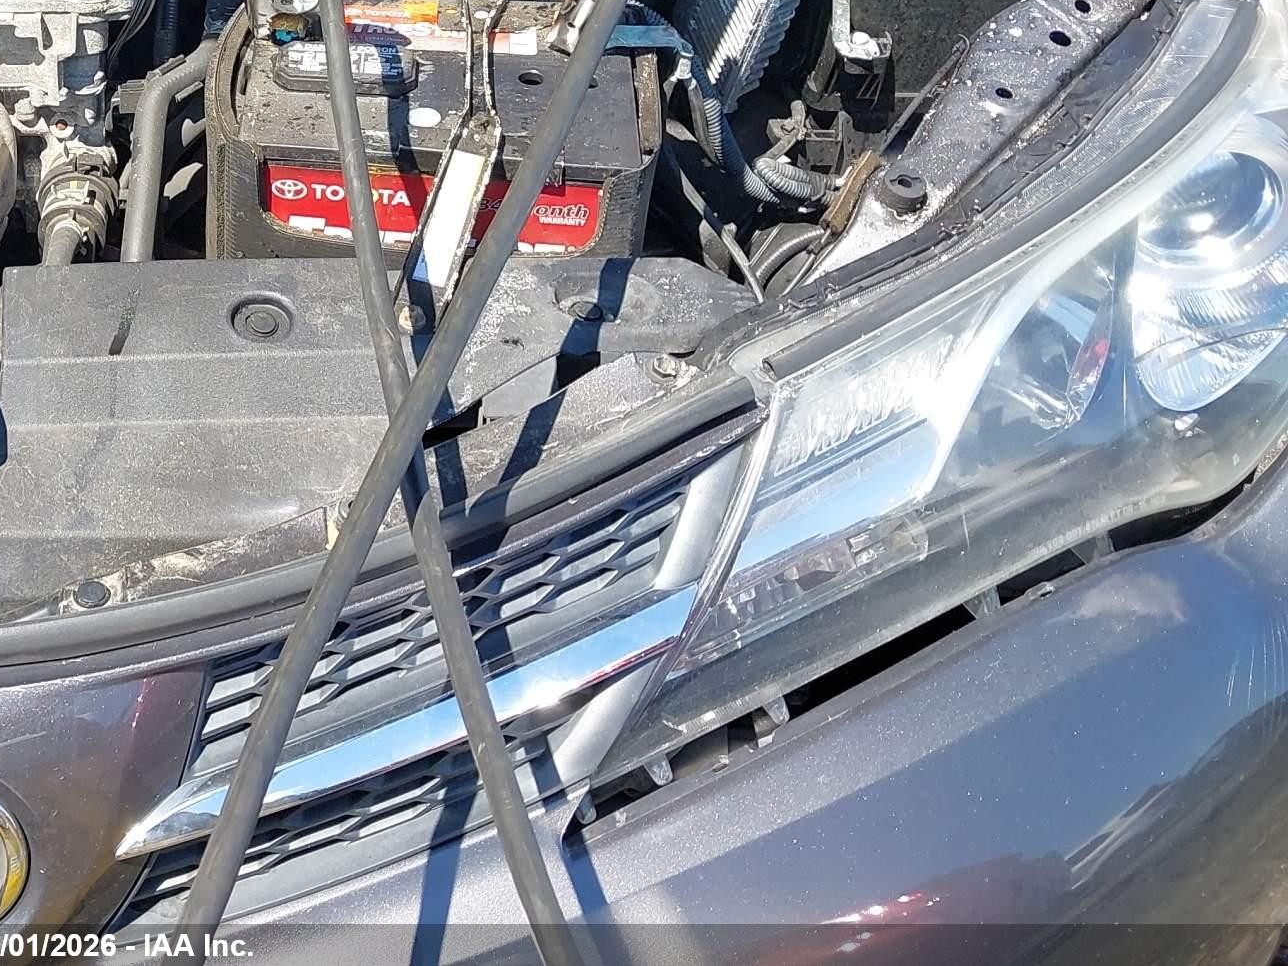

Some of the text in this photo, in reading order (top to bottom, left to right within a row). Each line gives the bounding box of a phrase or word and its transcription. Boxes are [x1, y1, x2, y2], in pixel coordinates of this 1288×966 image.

[311, 183, 411, 206] TOTA
[534, 203, 589, 220] onth
[539, 216, 587, 227] WARRANTY
